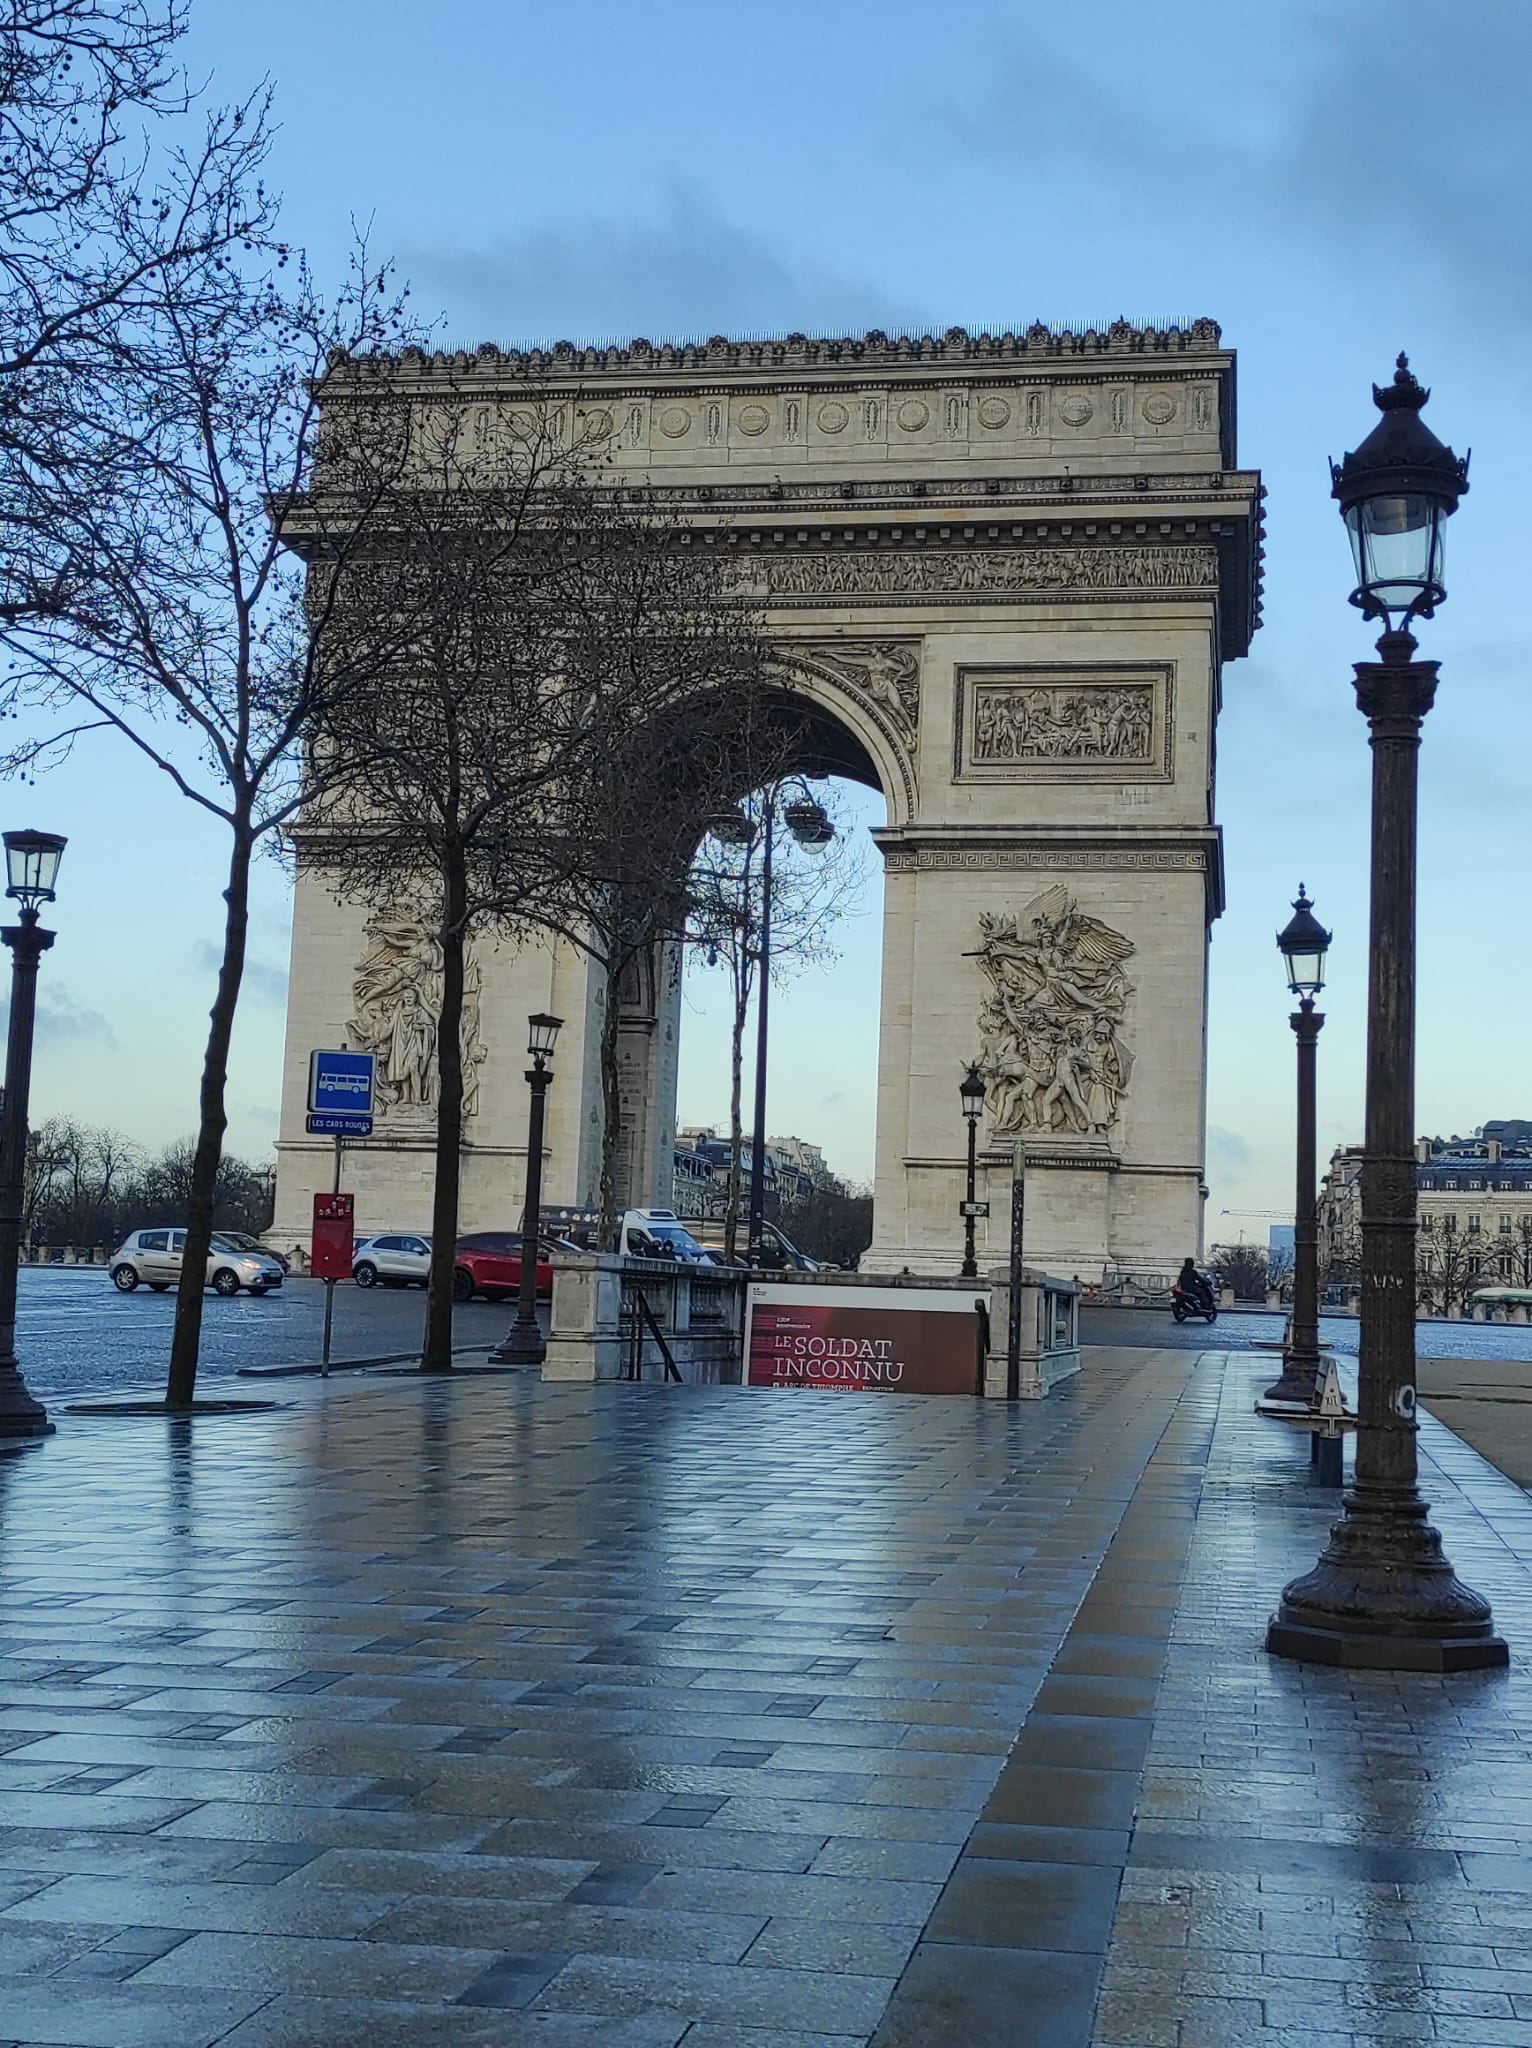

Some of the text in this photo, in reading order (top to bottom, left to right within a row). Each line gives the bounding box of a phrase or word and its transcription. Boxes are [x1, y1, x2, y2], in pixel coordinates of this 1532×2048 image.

[312, 1119, 324, 1127] LES
[325, 1120, 343, 1128] CARS
[774, 1335, 893, 1359] LE SOLDAT
[773, 1357, 904, 1381] INCONNU
